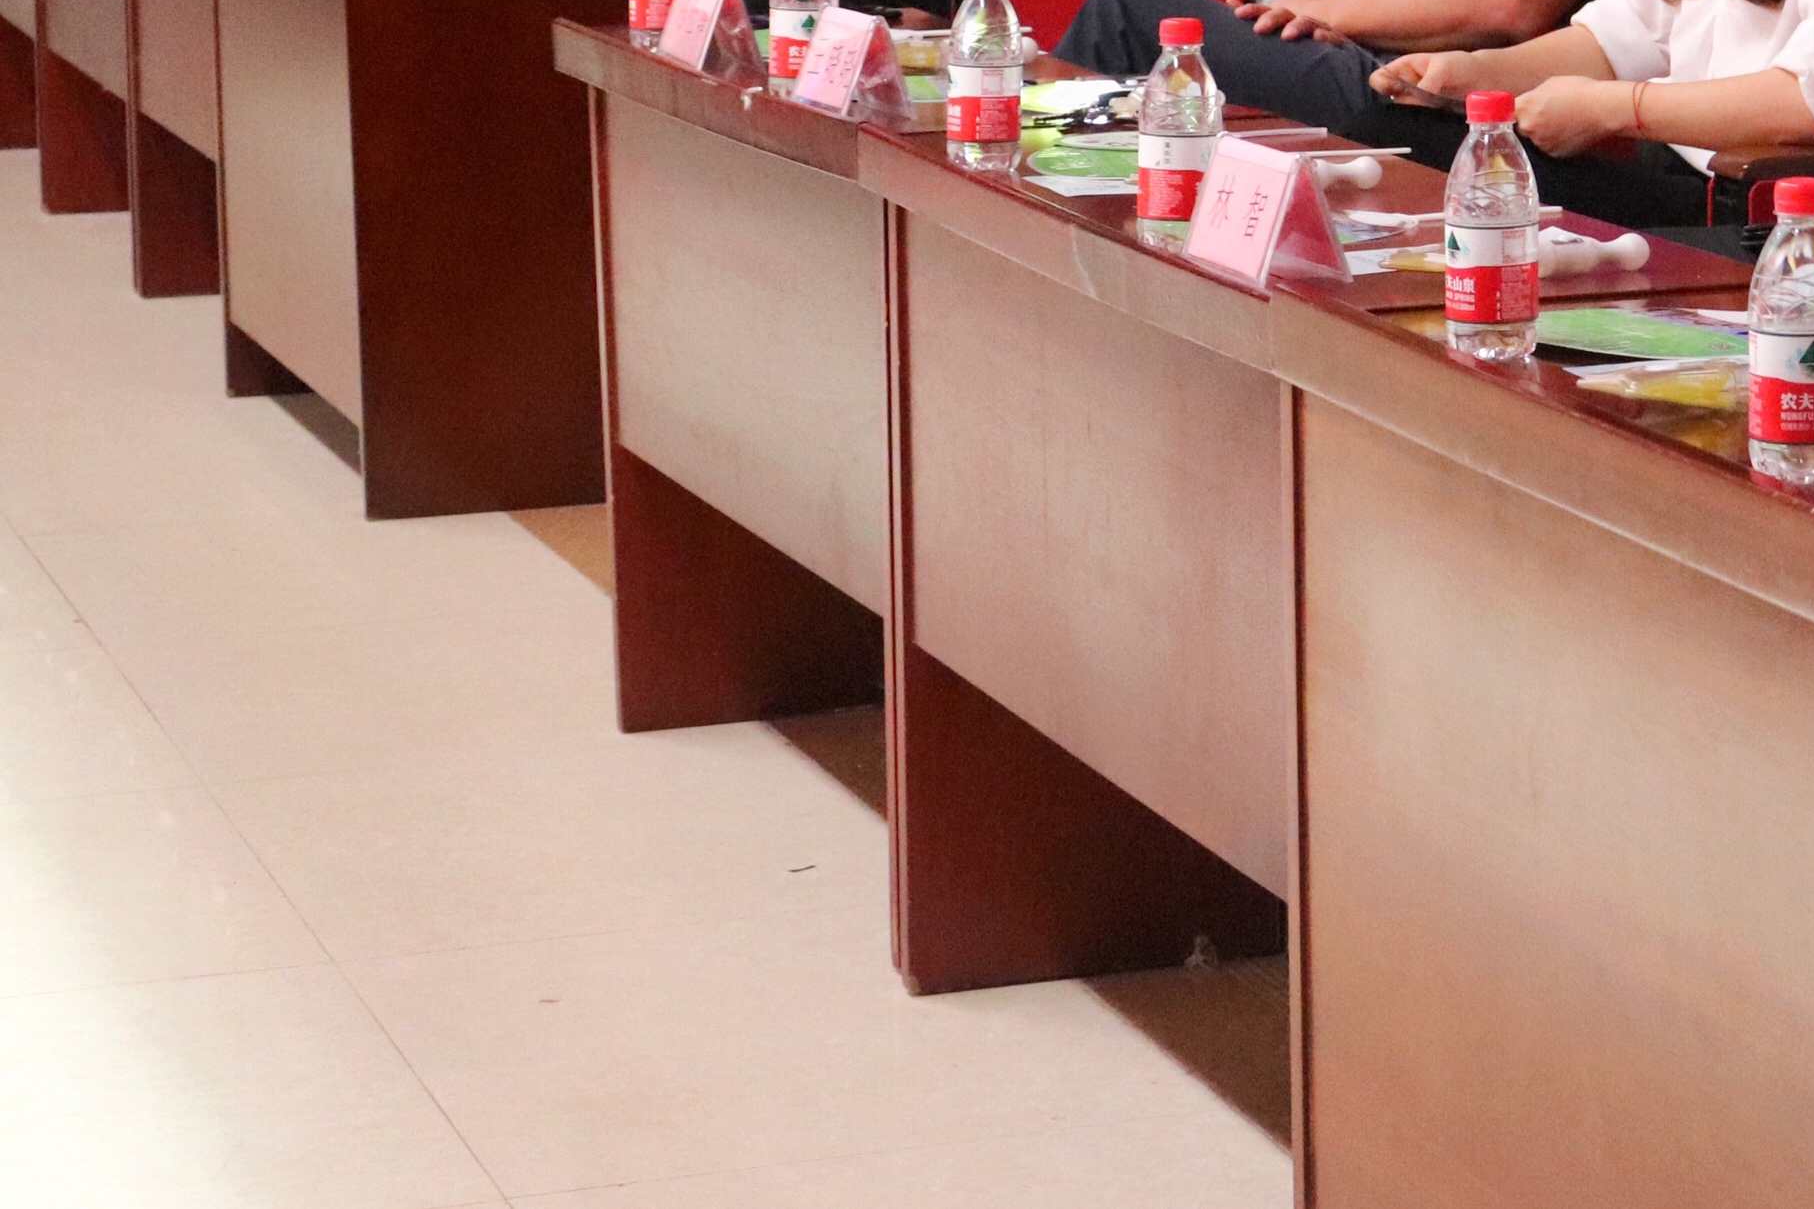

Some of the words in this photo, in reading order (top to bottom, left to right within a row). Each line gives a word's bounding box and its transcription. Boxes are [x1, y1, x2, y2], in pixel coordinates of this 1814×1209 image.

[1207, 174, 1269, 238] 林智
[1445, 274, 1475, 293] 夫山泉
